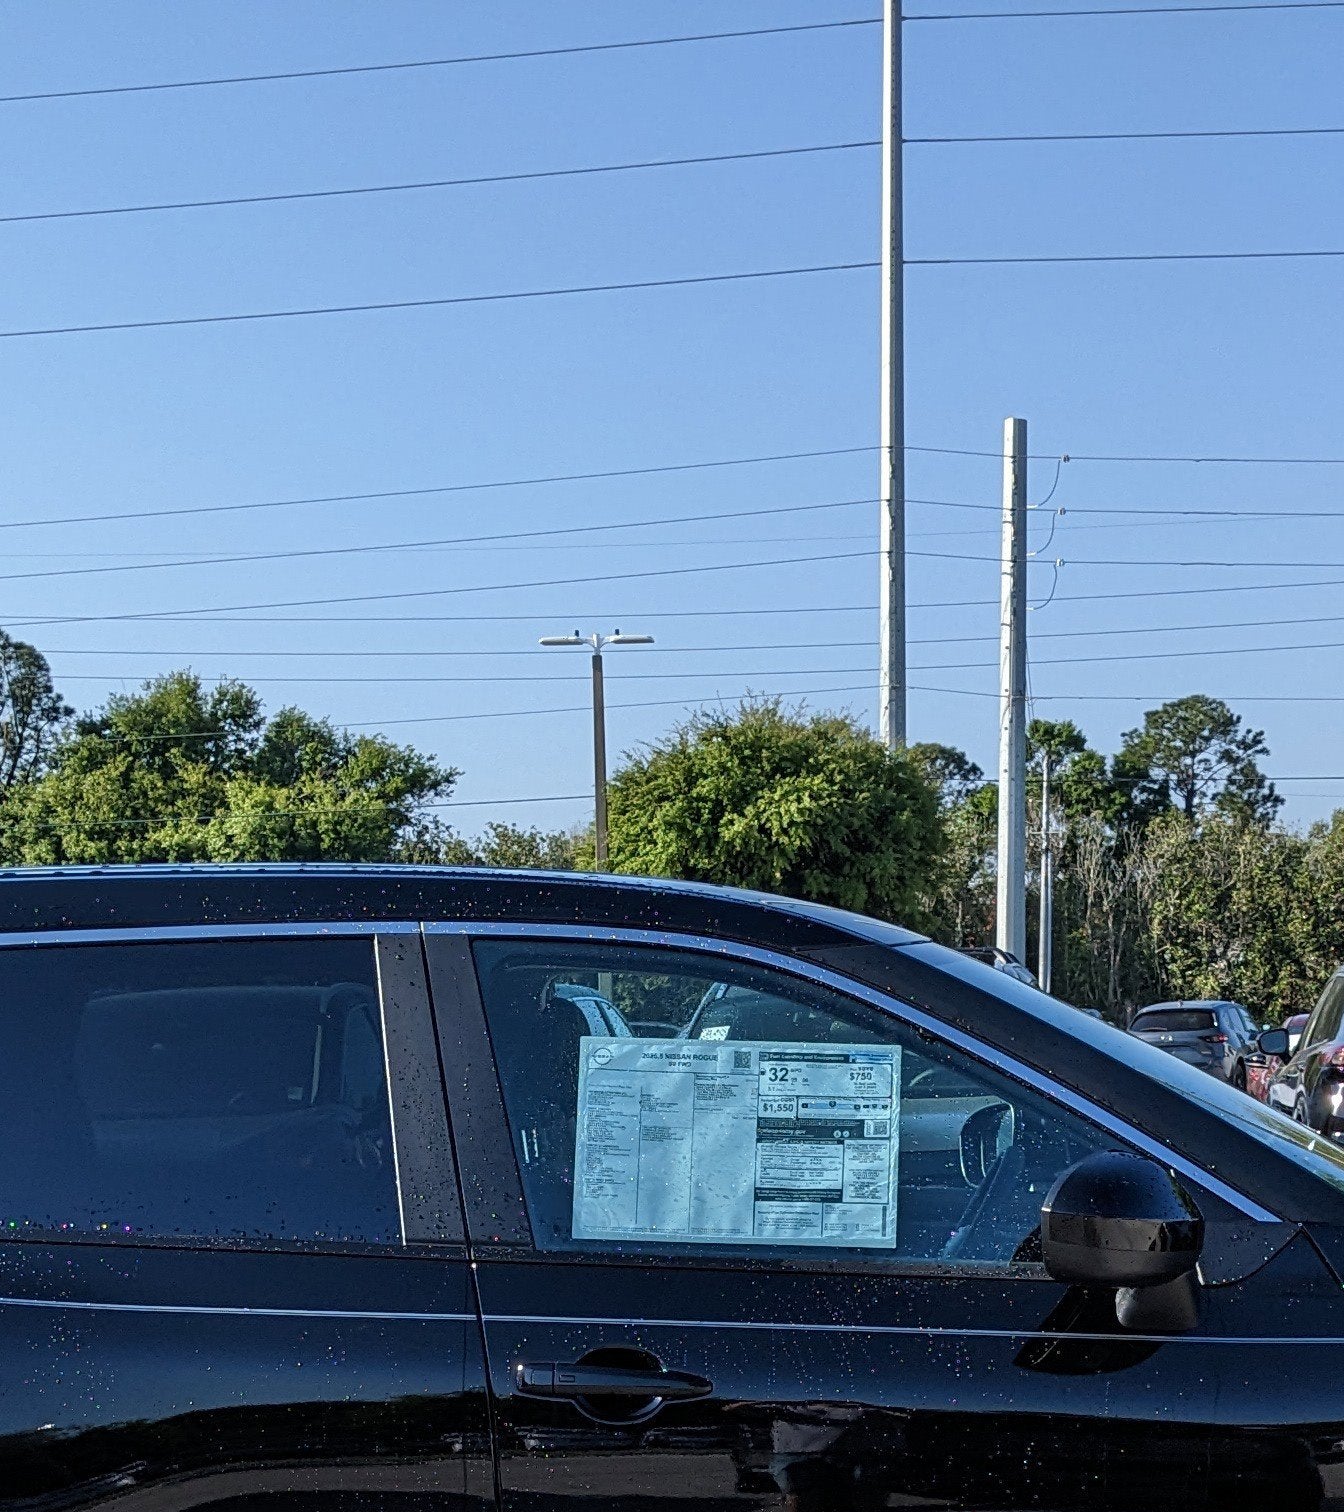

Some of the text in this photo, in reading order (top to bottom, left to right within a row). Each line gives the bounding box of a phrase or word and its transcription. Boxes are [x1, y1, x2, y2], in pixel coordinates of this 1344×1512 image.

[693, 1054, 719, 1062] ROGUE
[768, 1067, 789, 1082] 32
[849, 1072, 872, 1082] $750
[762, 1103, 794, 1114] $1,550
